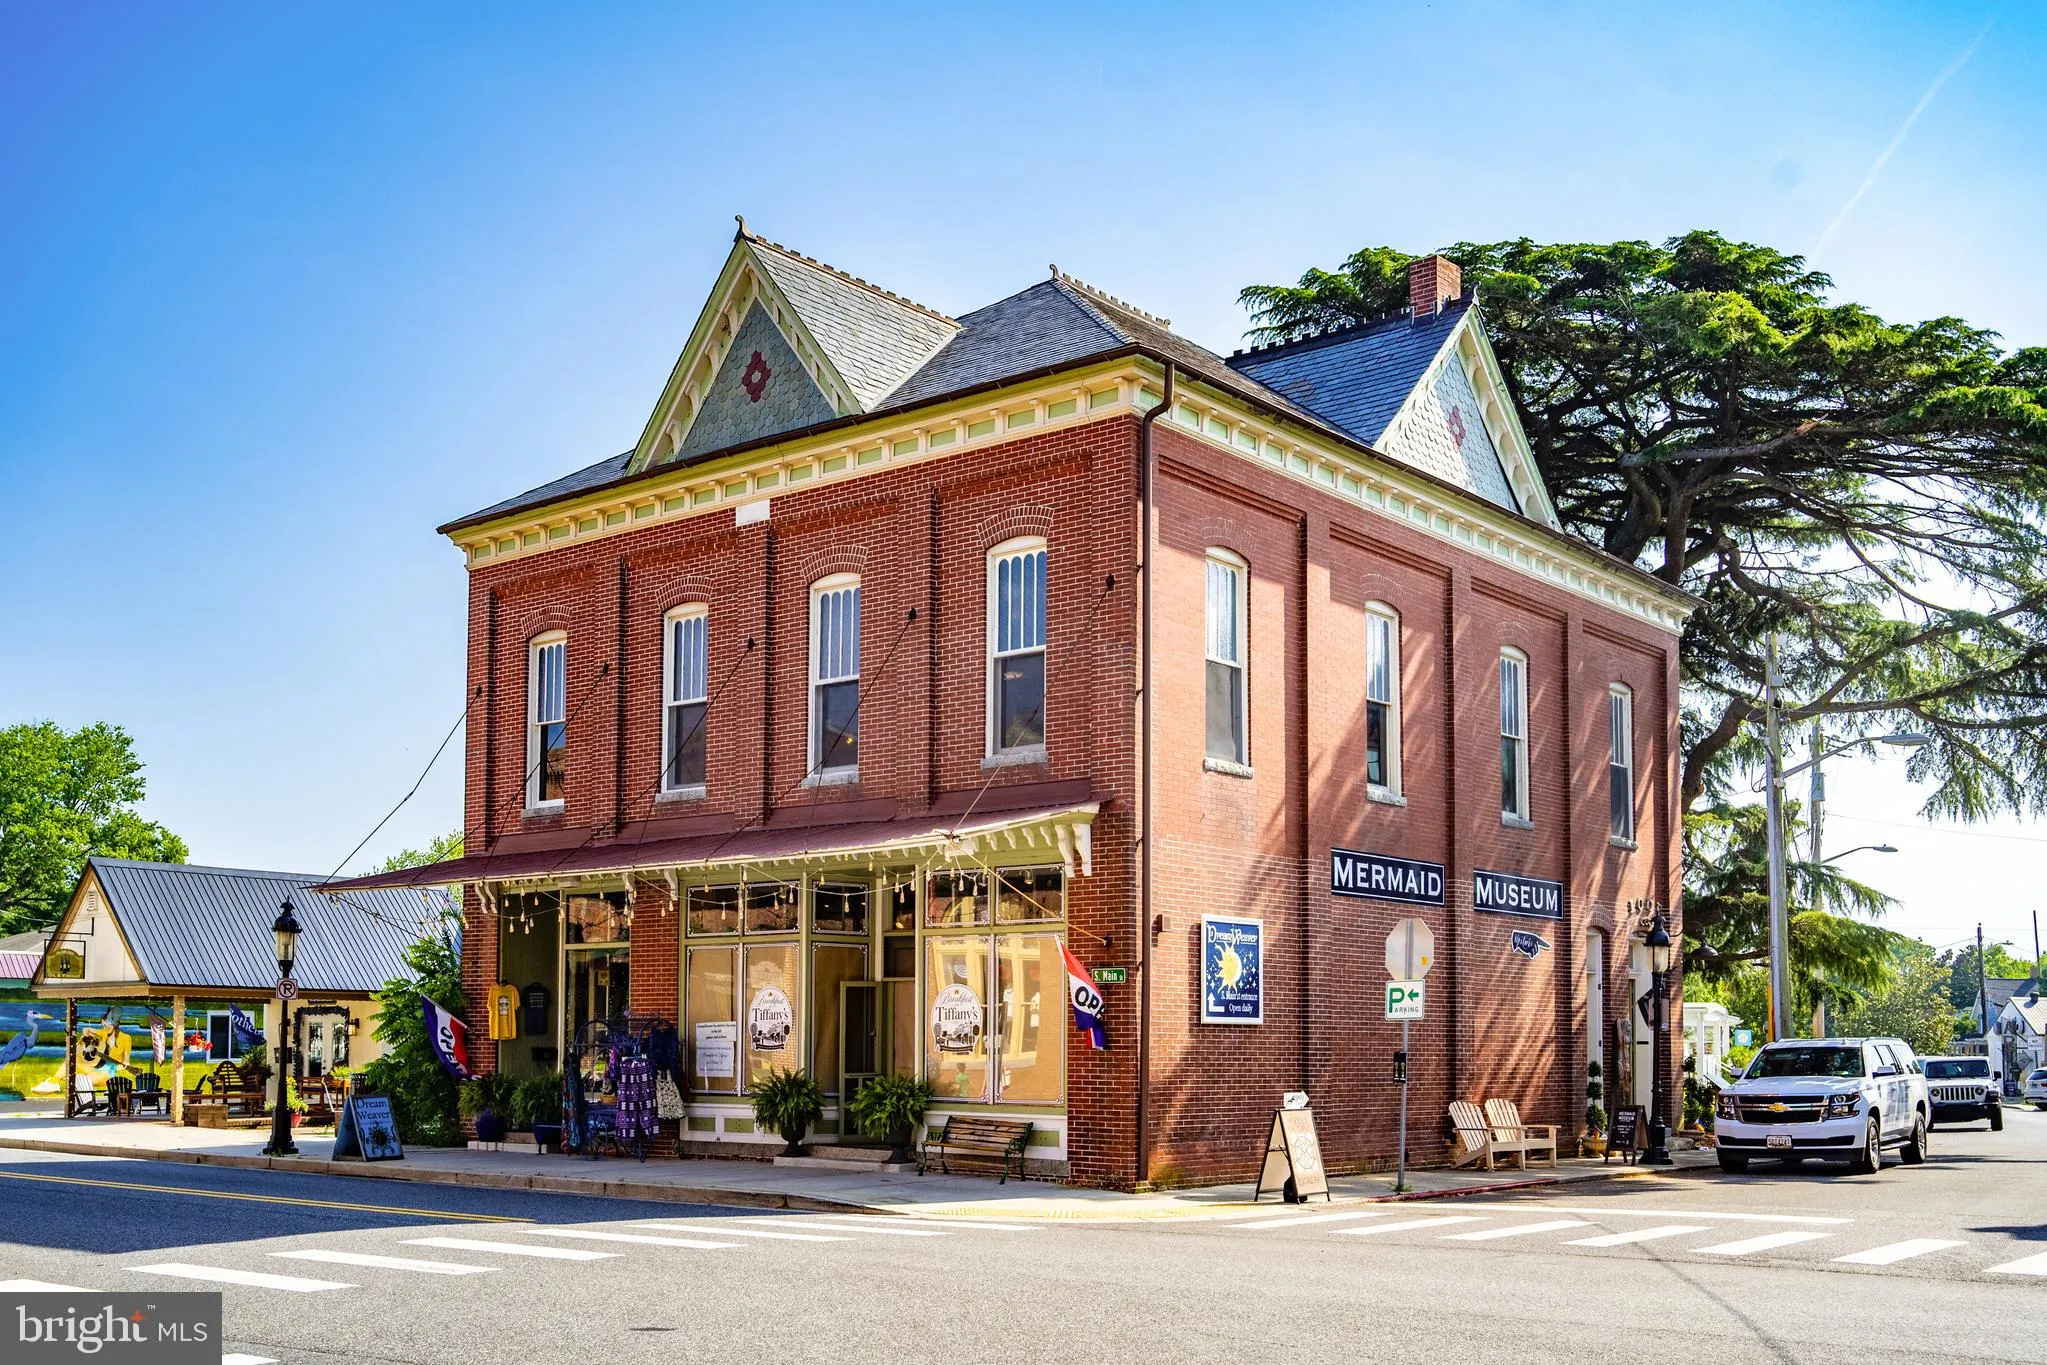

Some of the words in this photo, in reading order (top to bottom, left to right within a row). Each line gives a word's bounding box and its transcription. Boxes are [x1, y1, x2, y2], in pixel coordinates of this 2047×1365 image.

[1333, 856, 1442, 897] MERMAID
[1475, 876, 1559, 911] MUSEUM
[1102, 970, 1118, 982] Main
[1241, 992, 1258, 1001] entrance
[1388, 987, 1420, 1014] PARKING
[752, 1007, 789, 1022] Tiffany's
[935, 1006, 978, 1022] Tiffany's
[1228, 1003, 1242, 1014] Open
[1241, 1003, 1254, 1014] daily
[356, 1098, 387, 1109] Dream
[357, 1110, 390, 1120] Weaver
